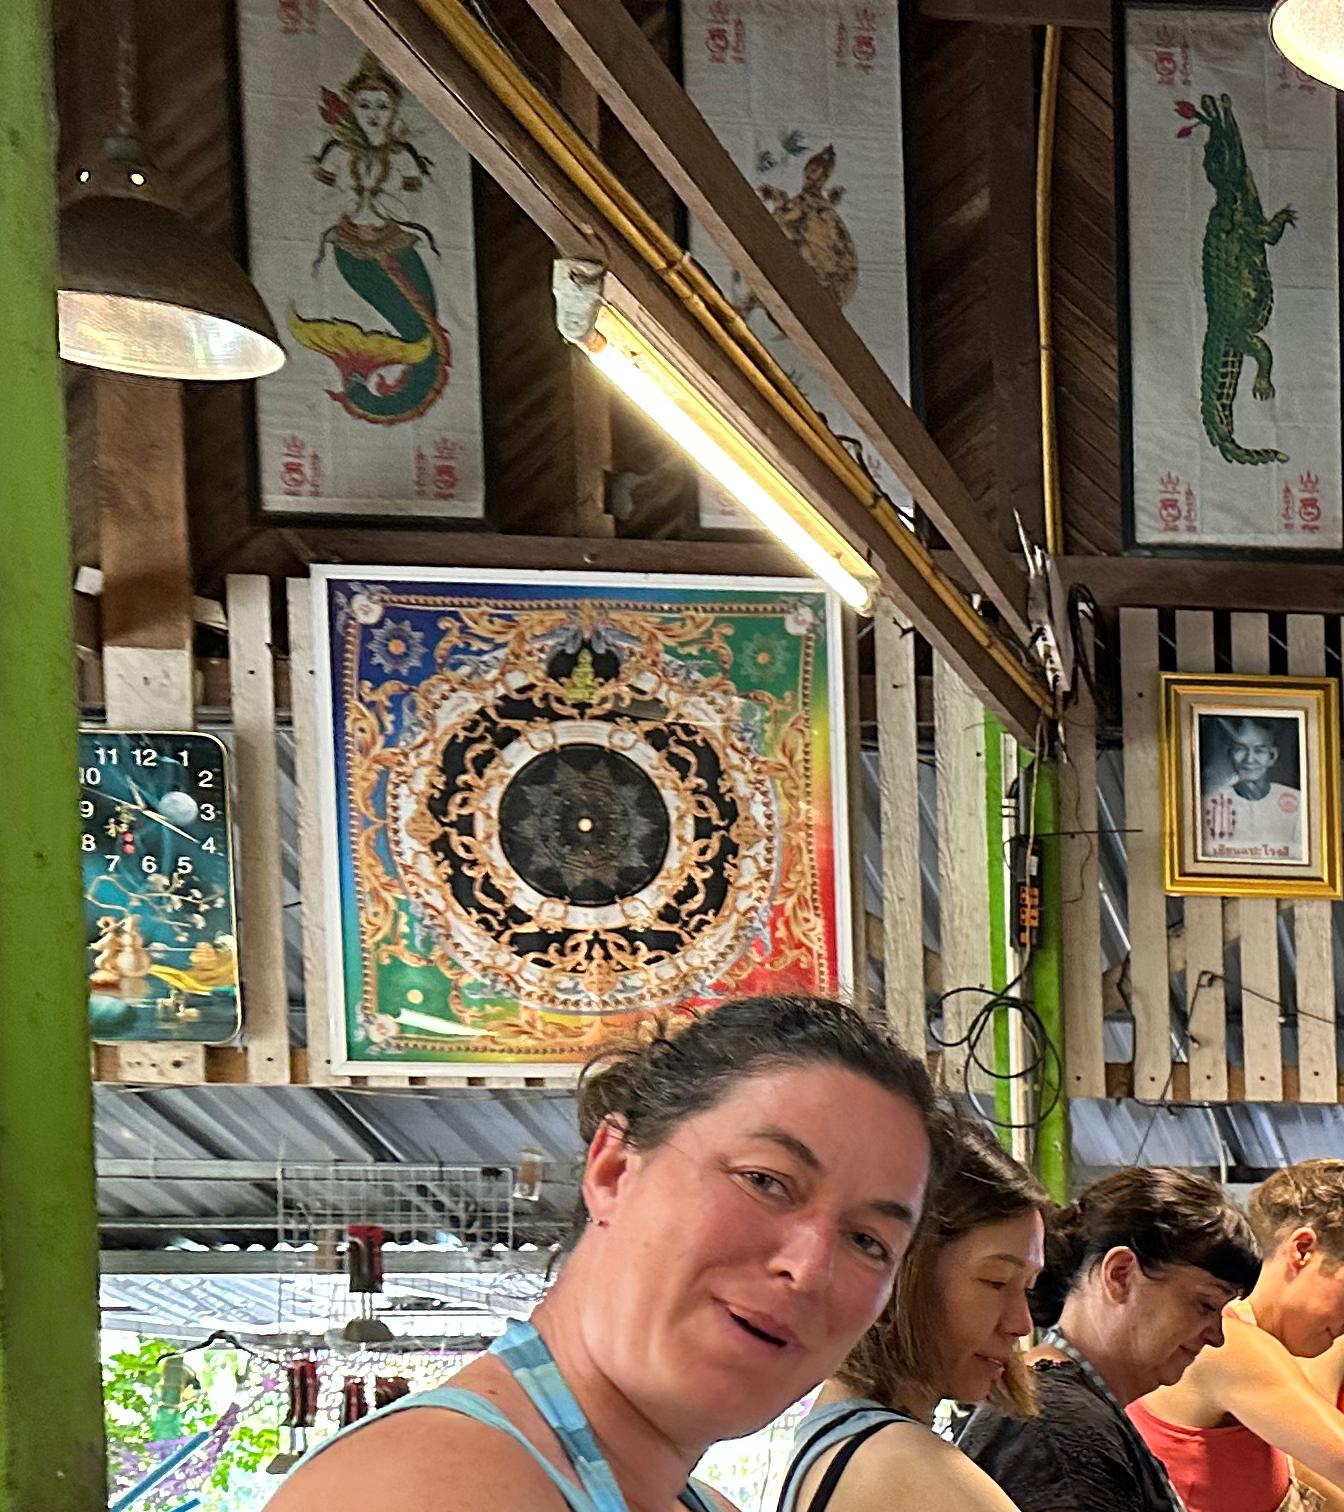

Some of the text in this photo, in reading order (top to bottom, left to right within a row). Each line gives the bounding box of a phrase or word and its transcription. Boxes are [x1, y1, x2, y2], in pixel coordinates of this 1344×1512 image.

[95, 748, 118, 765] 11
[131, 748, 158, 767] 12
[178, 750, 189, 767] 1
[198, 770, 214, 788] 2
[80, 800, 94, 818] 9
[200, 803, 216, 821] 3
[81, 834, 96, 852] 8
[201, 836, 217, 854] 4
[104, 855, 120, 872] 7
[141, 855, 157, 873] 6
[177, 856, 193, 874] 5
